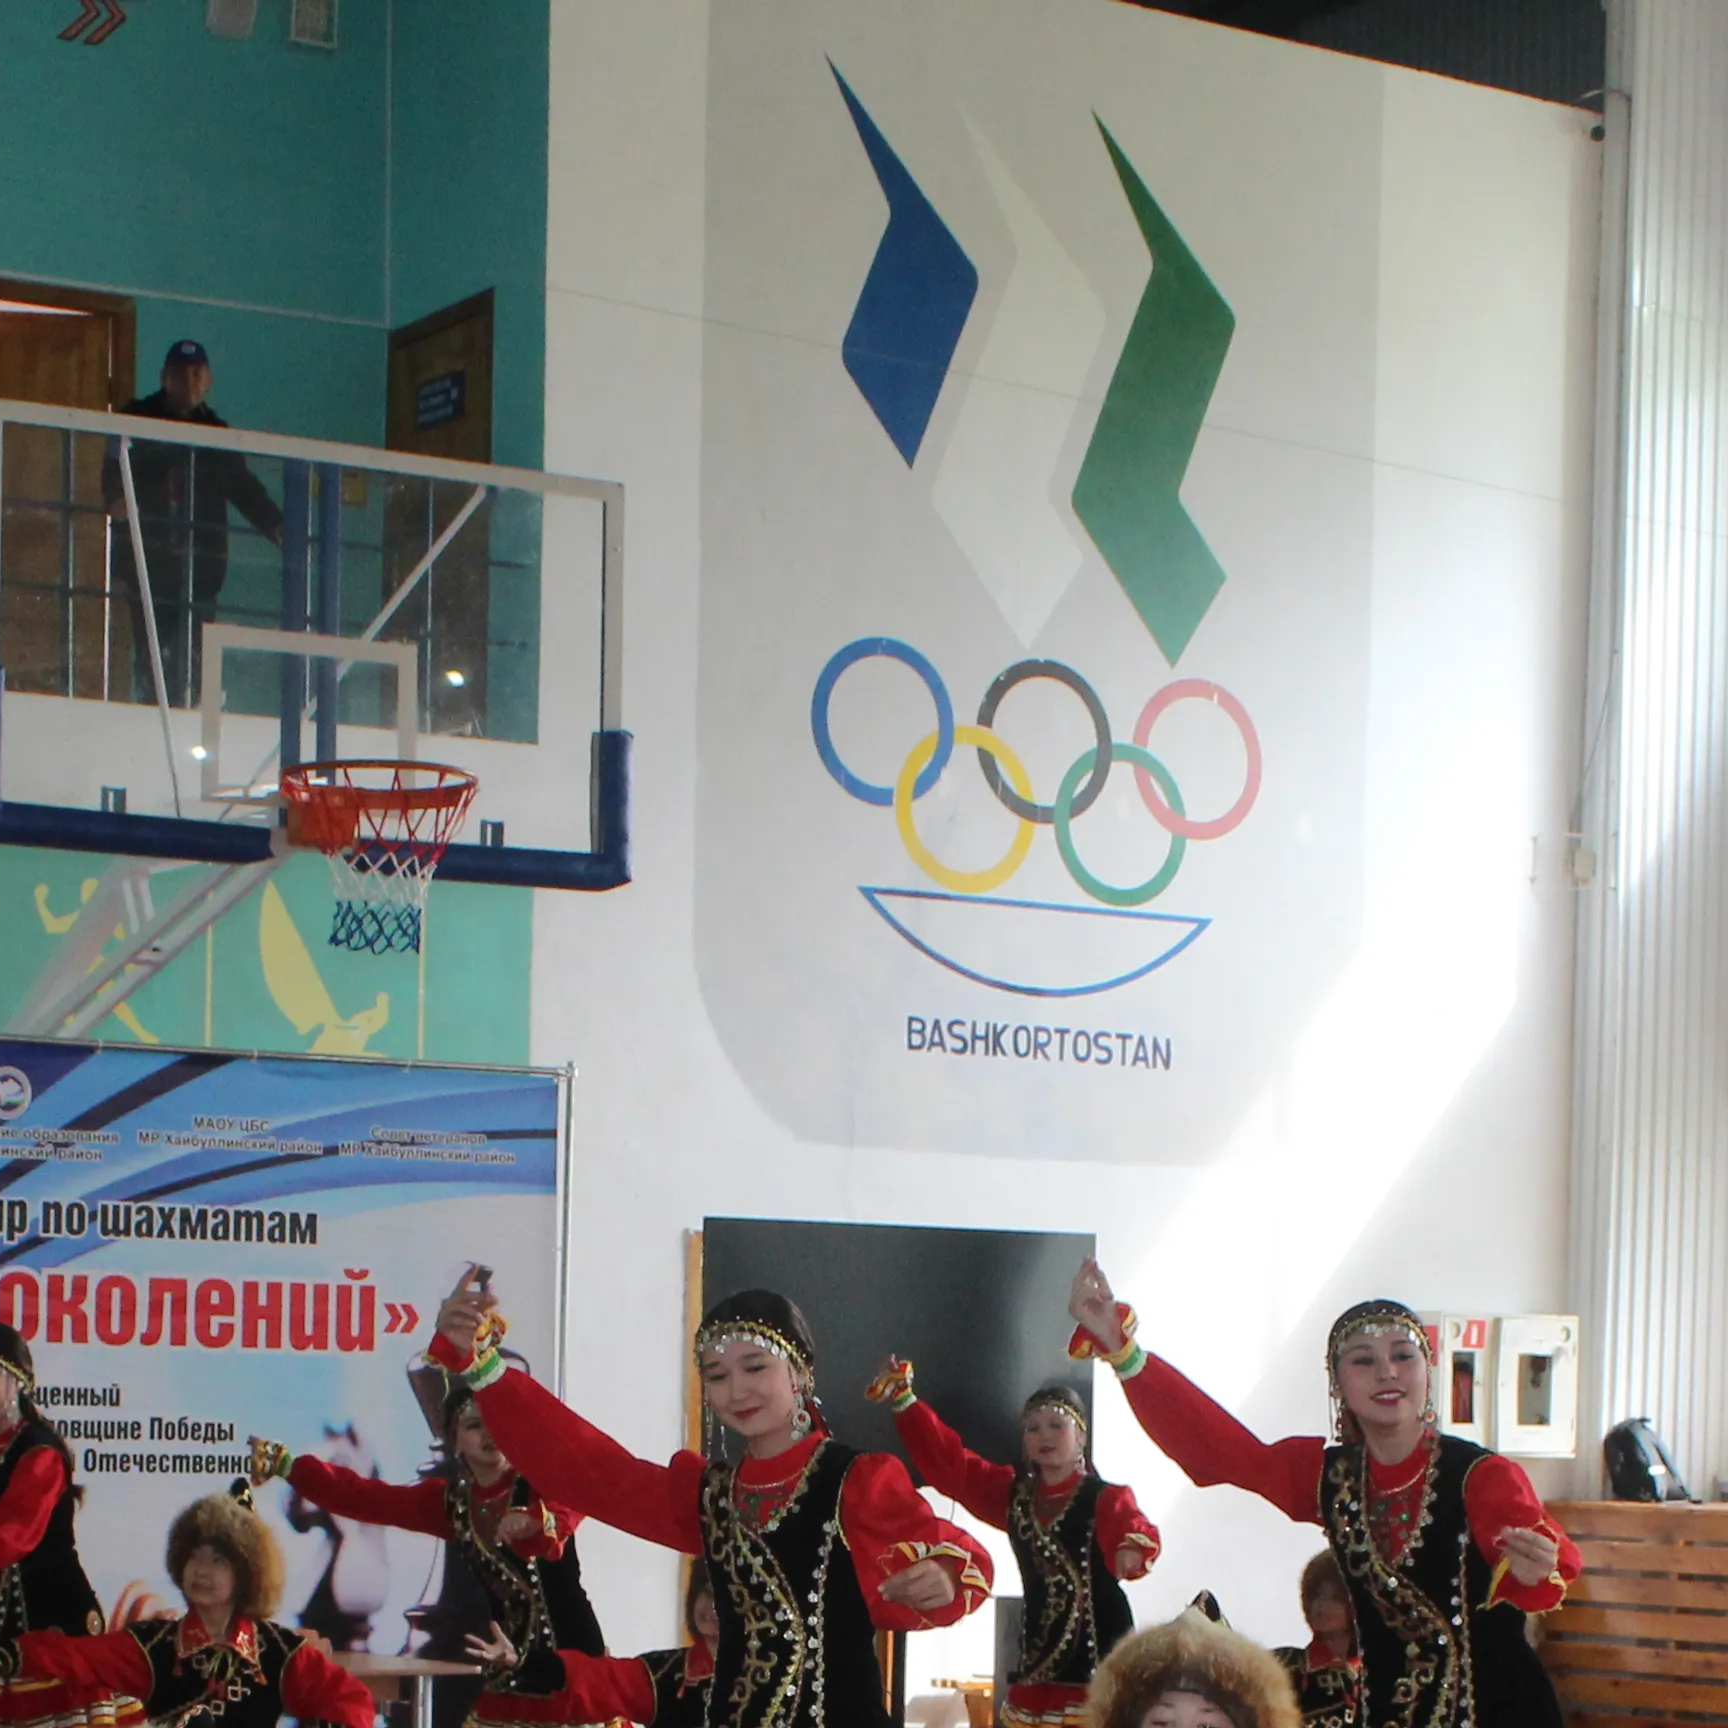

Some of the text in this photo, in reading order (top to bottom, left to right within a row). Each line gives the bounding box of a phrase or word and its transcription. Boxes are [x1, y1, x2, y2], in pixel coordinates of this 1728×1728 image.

[905, 1015, 1172, 1071] BASHKORTOSTAN
[22, 1125, 120, 1144] образования
[192, 1115, 270, 1134] МАОУ ЦБС
[57, 1143, 103, 1162] район
[138, 1130, 161, 1145] МР
[278, 1136, 323, 1155] район
[339, 1141, 362, 1156] МР
[474, 1149, 516, 1165] район
[40, 1199, 88, 1237] по
[98, 1202, 319, 1246] шахматам
[33, 1384, 121, 1408] щенный
[51, 1416, 234, 1444] овщине Победы
[83, 1447, 253, 1475] Отечественно
